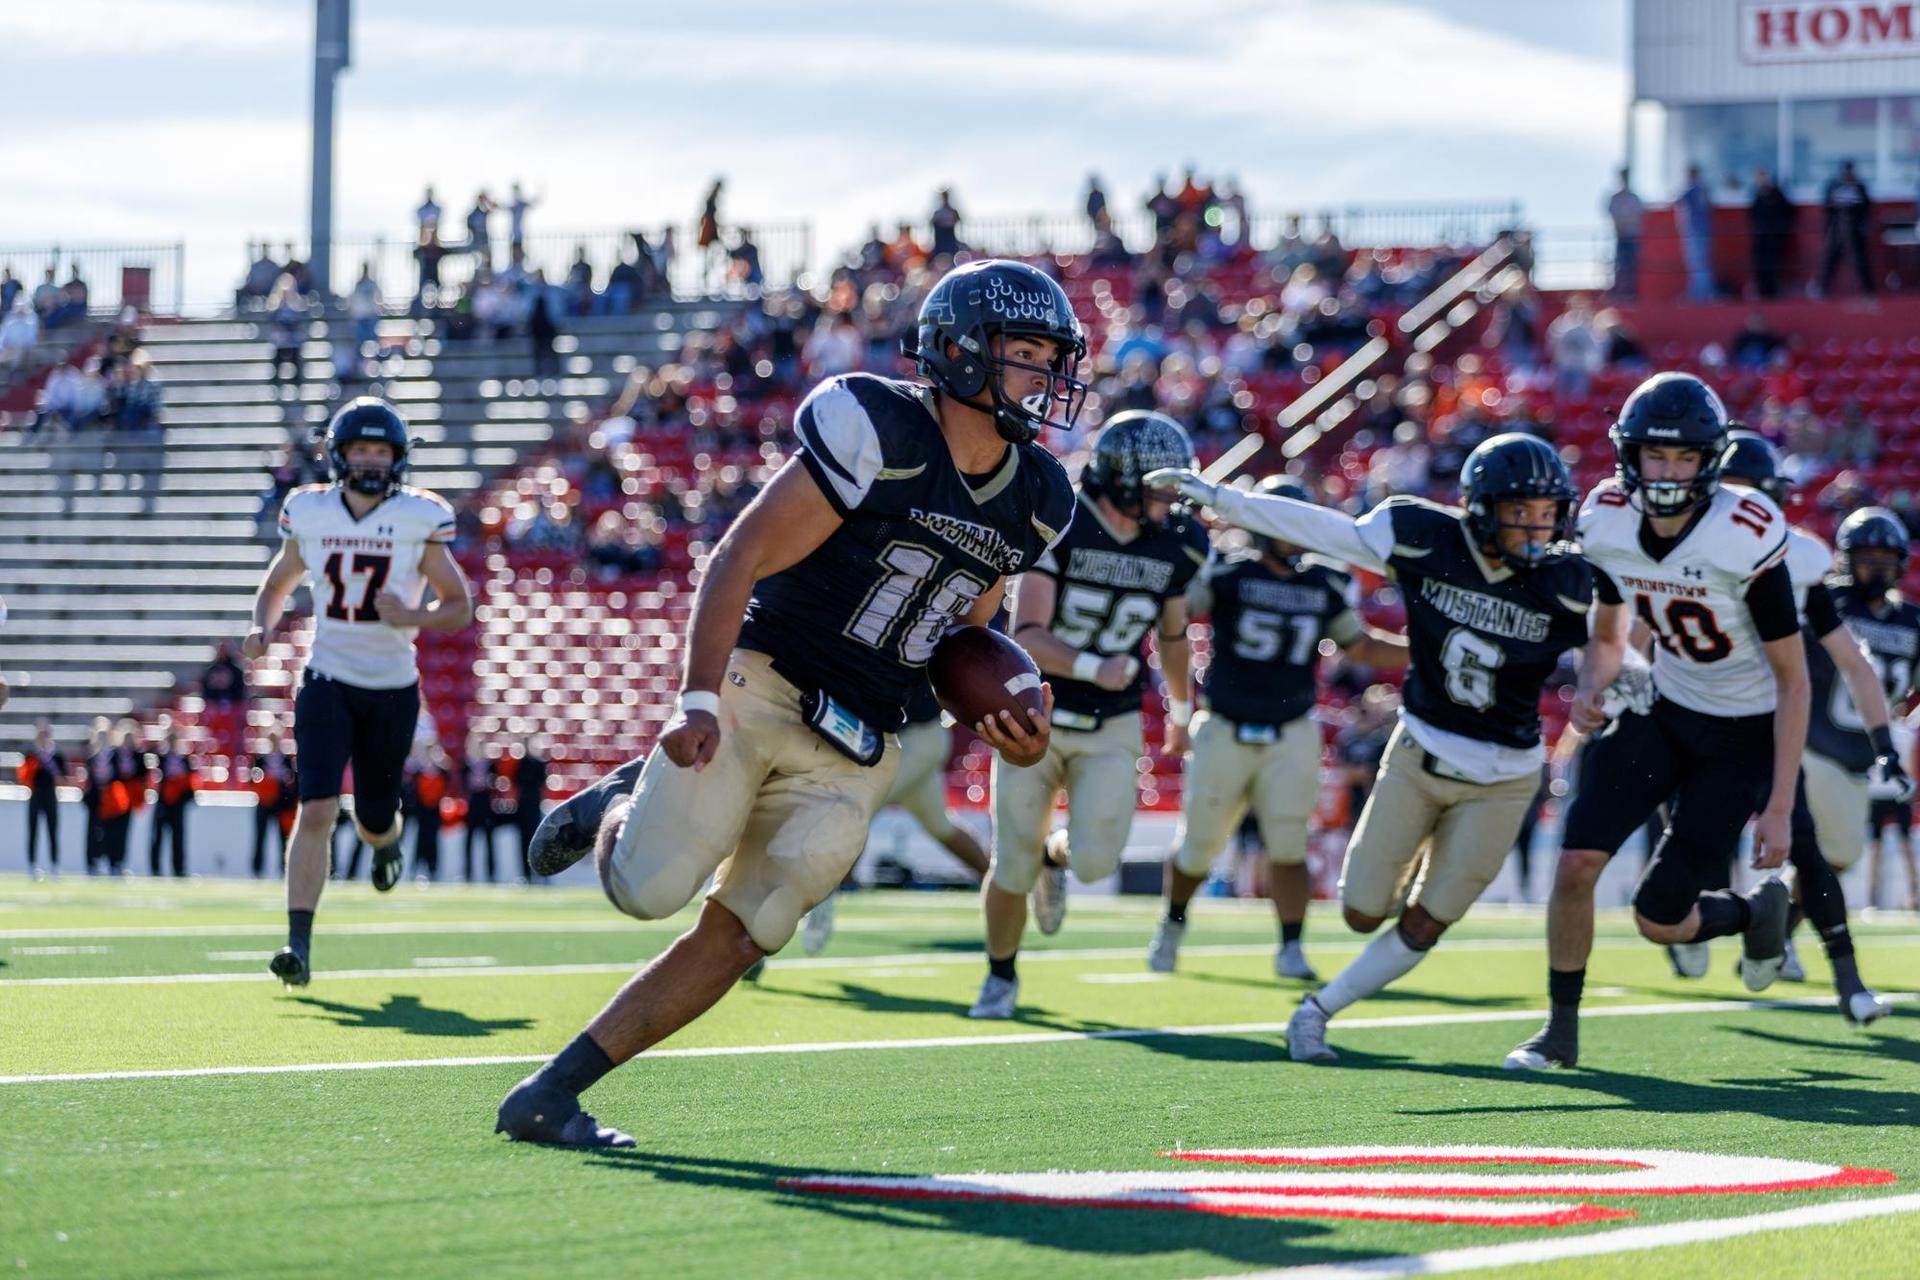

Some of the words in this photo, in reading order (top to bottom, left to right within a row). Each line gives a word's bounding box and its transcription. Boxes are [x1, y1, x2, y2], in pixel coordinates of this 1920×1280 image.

[1731, 499, 1773, 540] 10
[324, 552, 392, 622] 17
[1065, 547, 1175, 593] MUSTANGS
[1620, 576, 1708, 597] SPRINGTOWN
[1053, 583, 1158, 655] 56
[1421, 577, 1552, 643] MUSTANGS
[1634, 592, 1734, 662] 10
[1439, 625, 1507, 712] 6
